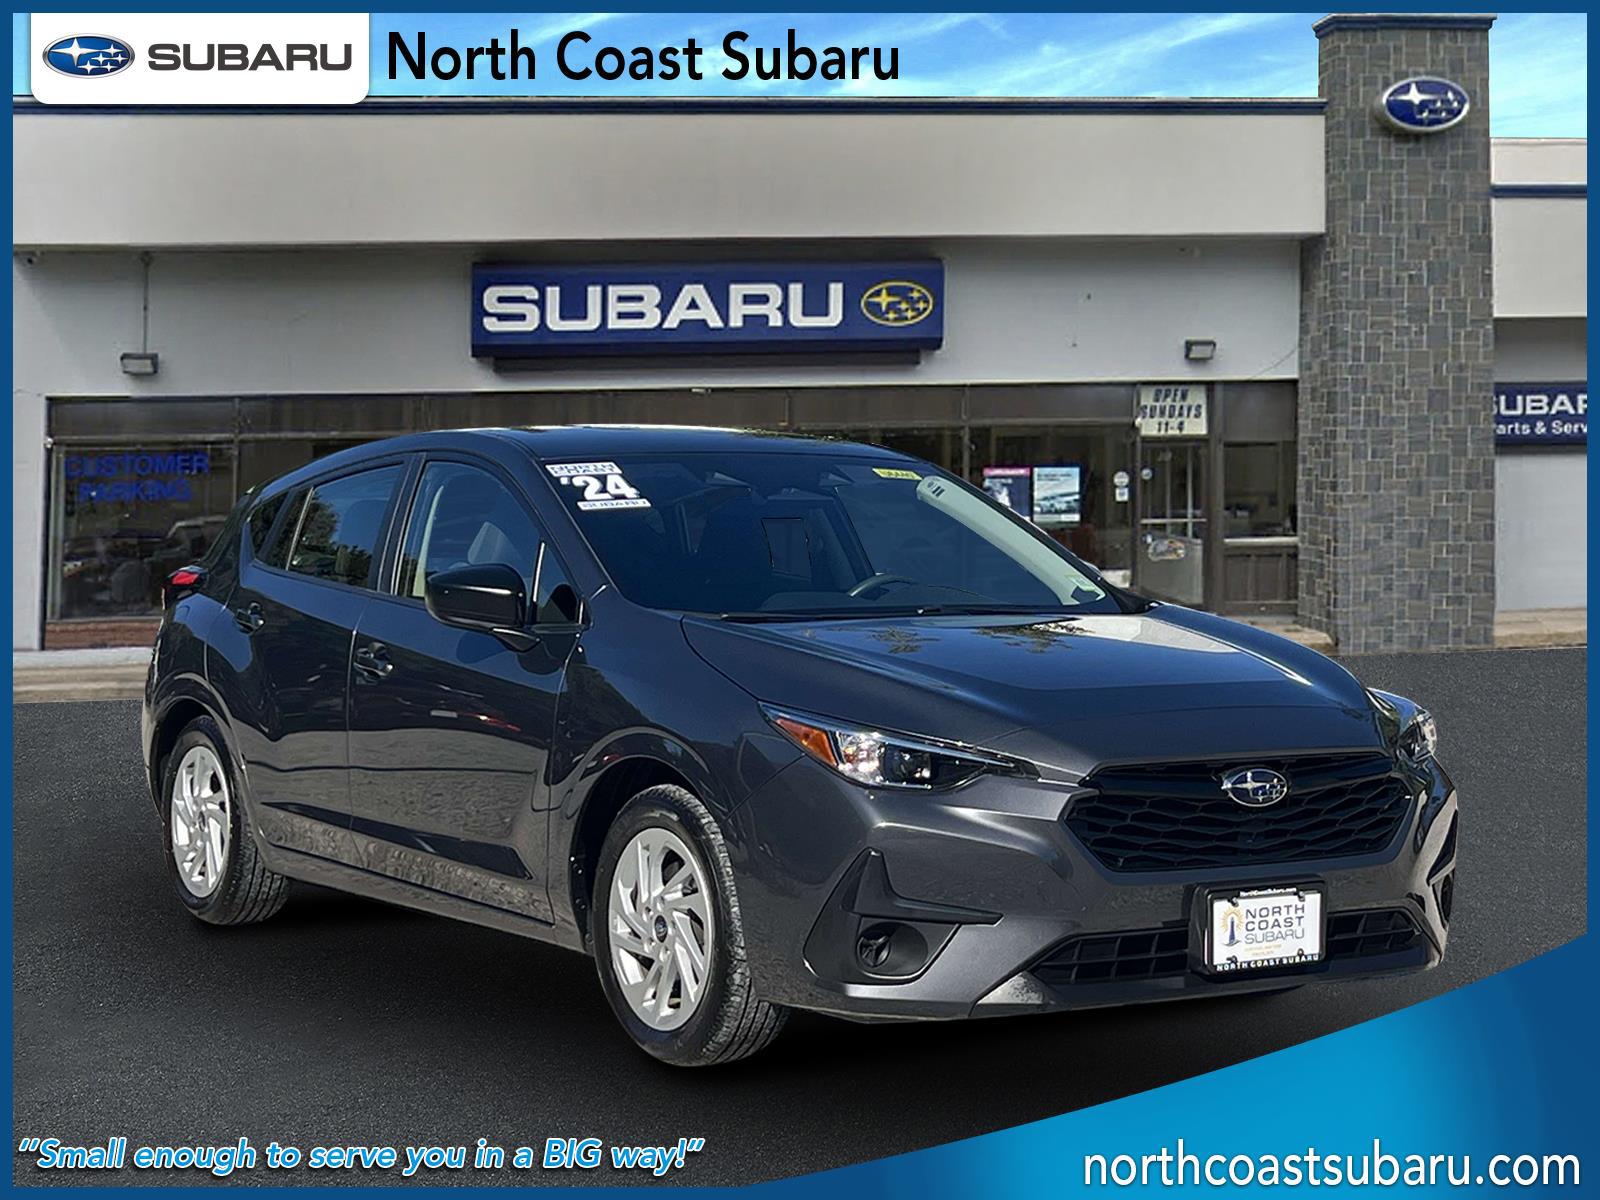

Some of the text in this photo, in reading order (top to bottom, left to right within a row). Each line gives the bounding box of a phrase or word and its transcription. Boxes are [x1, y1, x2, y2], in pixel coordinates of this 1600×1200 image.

[482, 282, 844, 332] SUBARU
[1140, 404, 1202, 419] SUNDAYS
[1534, 420, 1547, 435] &
[64, 453, 208, 477] CUSTOMER
[560, 474, 640, 500] '24
[1245, 904, 1305, 920] NORTH
[1245, 916, 1305, 932] COAST
[1244, 928, 1305, 945] SUBARU
[1216, 954, 1319, 971] NORTH COAST SUBARU
